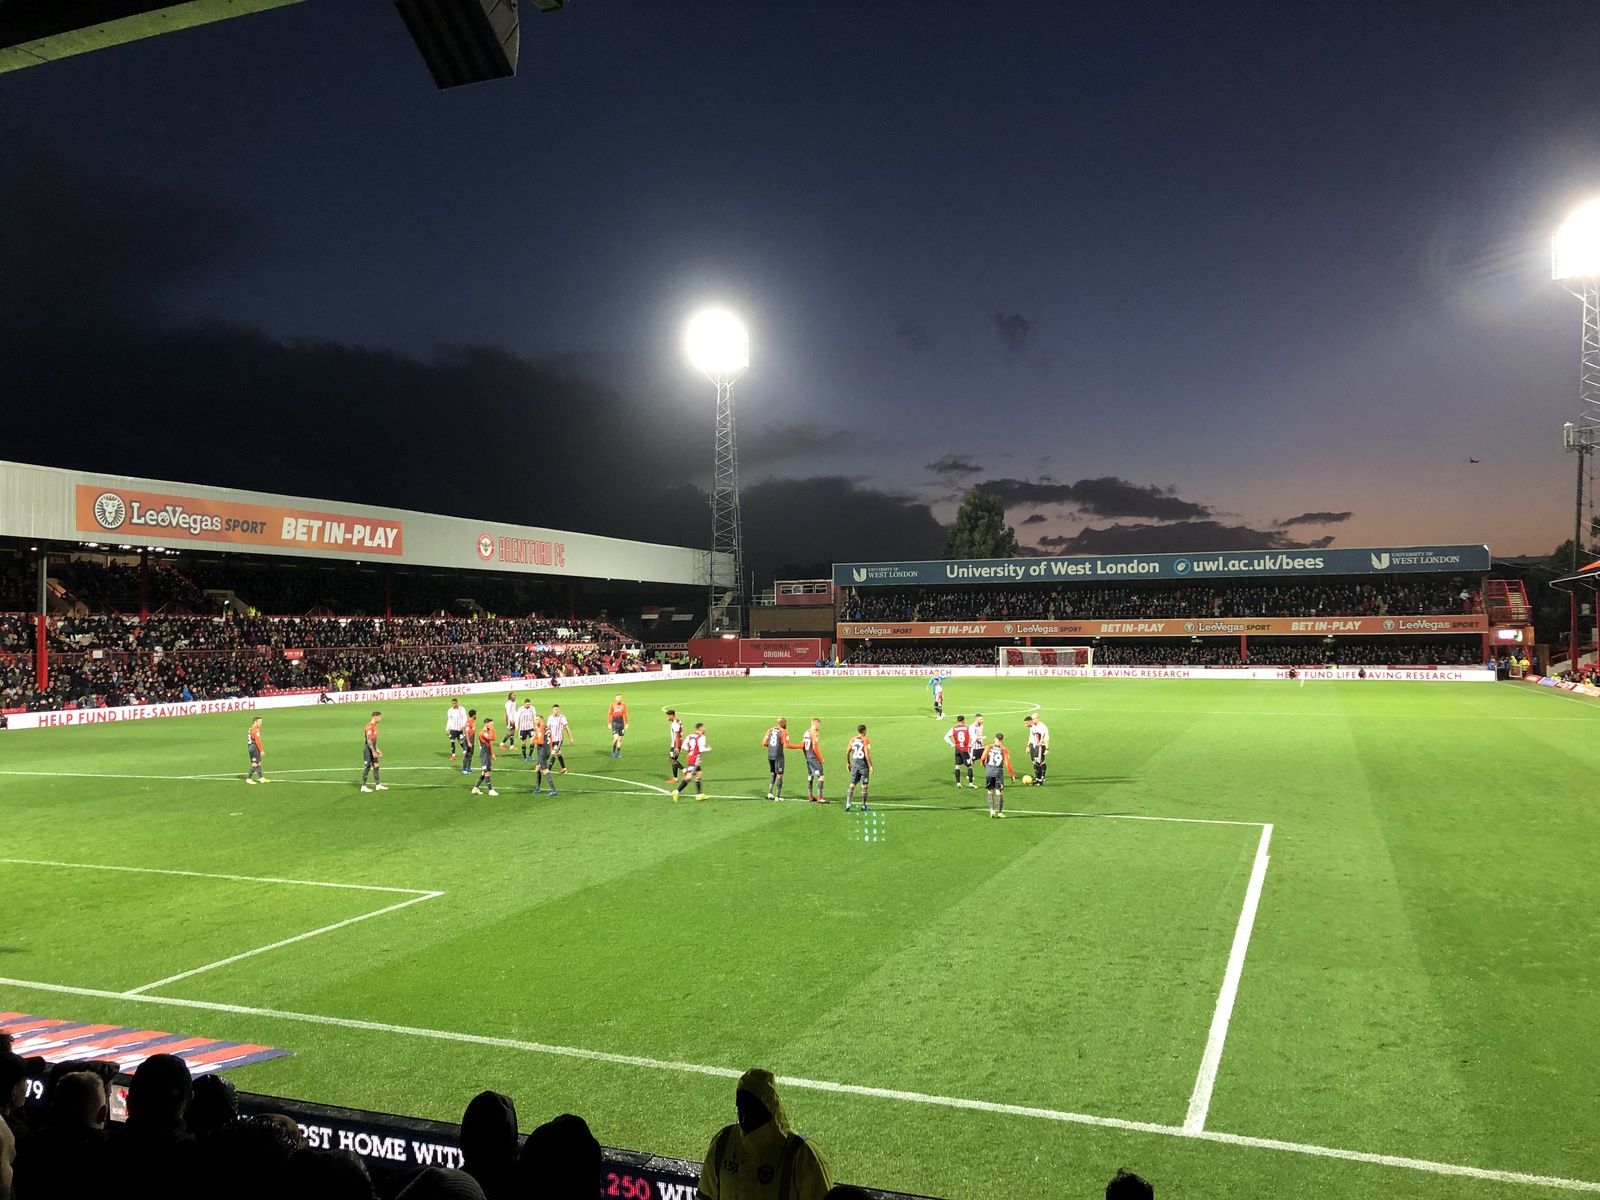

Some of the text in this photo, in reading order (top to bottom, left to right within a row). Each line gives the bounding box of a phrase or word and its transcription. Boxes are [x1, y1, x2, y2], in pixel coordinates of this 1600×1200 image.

[131, 502, 267, 534] LeoVegas SPORT
[281, 517, 398, 548] BET IN-PLAY
[499, 537, 552, 566] BRENTFORD
[555, 543, 565, 567] FC
[1193, 554, 1324, 572] uwl.ac.uk/bees
[1420, 556, 1460, 564] LONDON
[889, 570, 918, 578] LONDON
[946, 560, 1160, 580] University of West London
[929, 626, 987, 634] BET IN-PLAY
[1017, 624, 1058, 634] LeoVegas
[1100, 623, 1164, 632] BET IN-PLAY
[1198, 622, 1245, 633] LeoVegas
[1291, 621, 1361, 631] BET IN-PLAY
[1399, 620, 1480, 631] LeoVegas SPORT
[854, 627, 892, 636] LeoVegas
[1276, 671, 1300, 679] HEP
[1304, 671, 1333, 679] FUND
[1406, 672, 1462, 680] RESEARCH
[338, 686, 472, 703] HELP FUND LIFE-SAVING RESEARCH
[39, 700, 256, 728] HELP FUND LIFE-SAVING RESEARCH
[958, 730, 966, 742] 8
[988, 752, 1003, 766] 19
[338, 1130, 407, 1162] HOME
